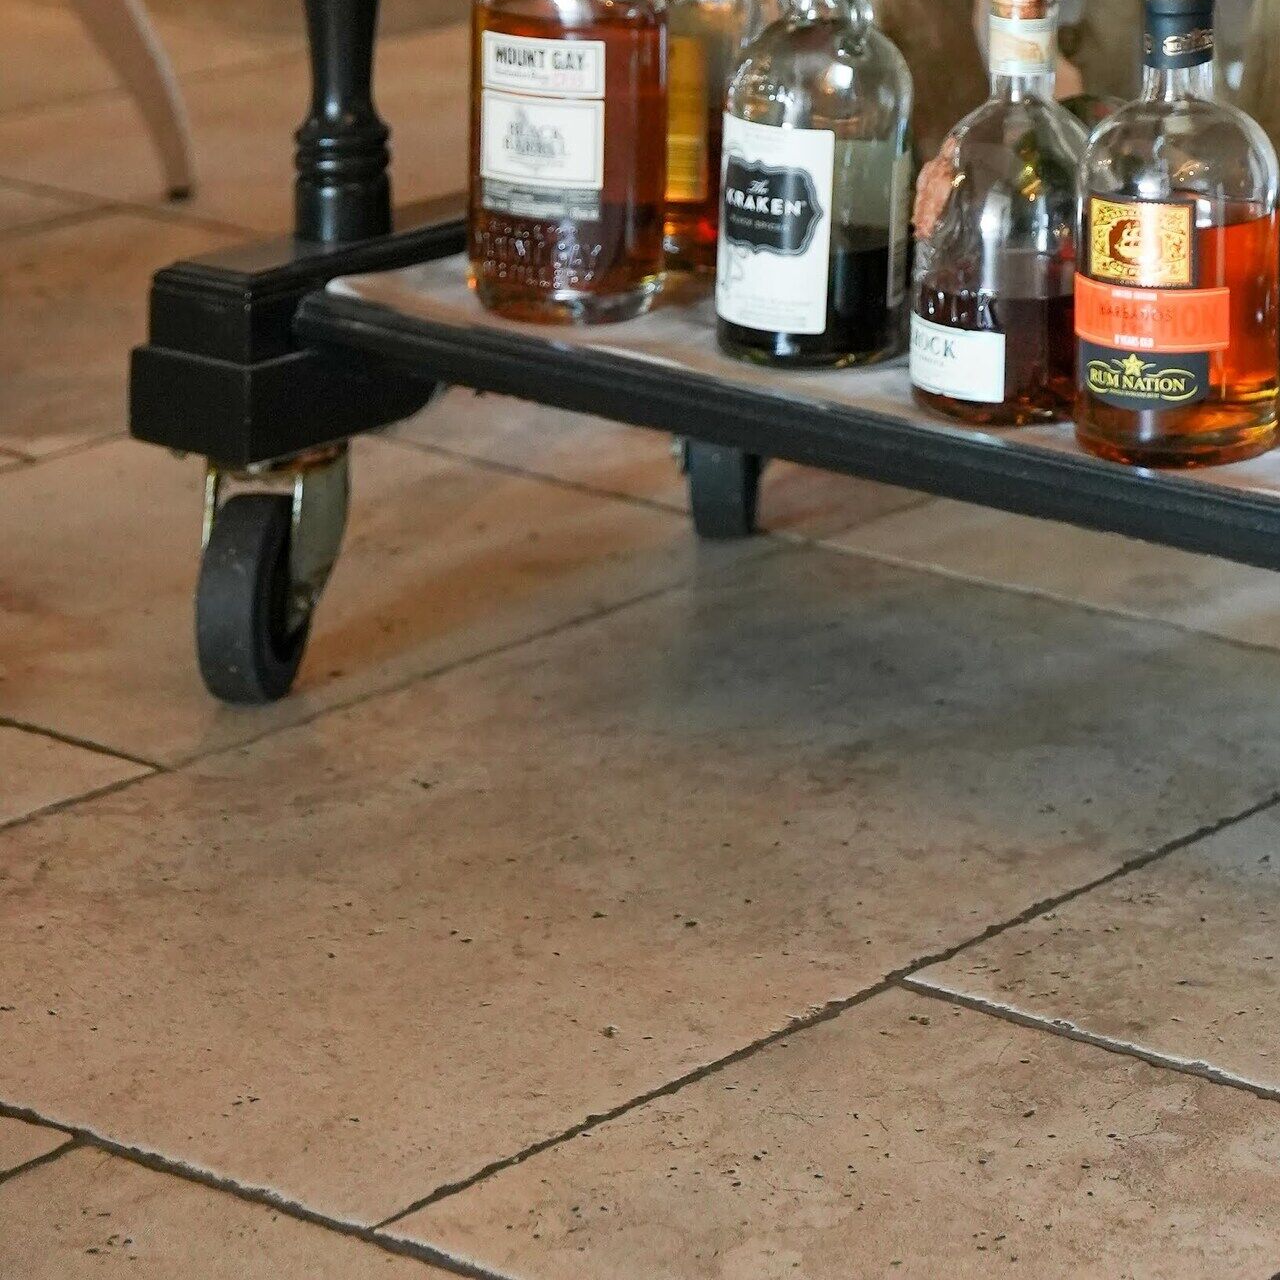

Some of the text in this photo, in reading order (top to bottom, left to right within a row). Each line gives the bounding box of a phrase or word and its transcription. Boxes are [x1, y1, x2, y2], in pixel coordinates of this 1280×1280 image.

[496, 46, 586, 71] MOUNT GAY
[726, 188, 803, 218] KRAKEN
[1090, 368, 1186, 392] RUM NATION
